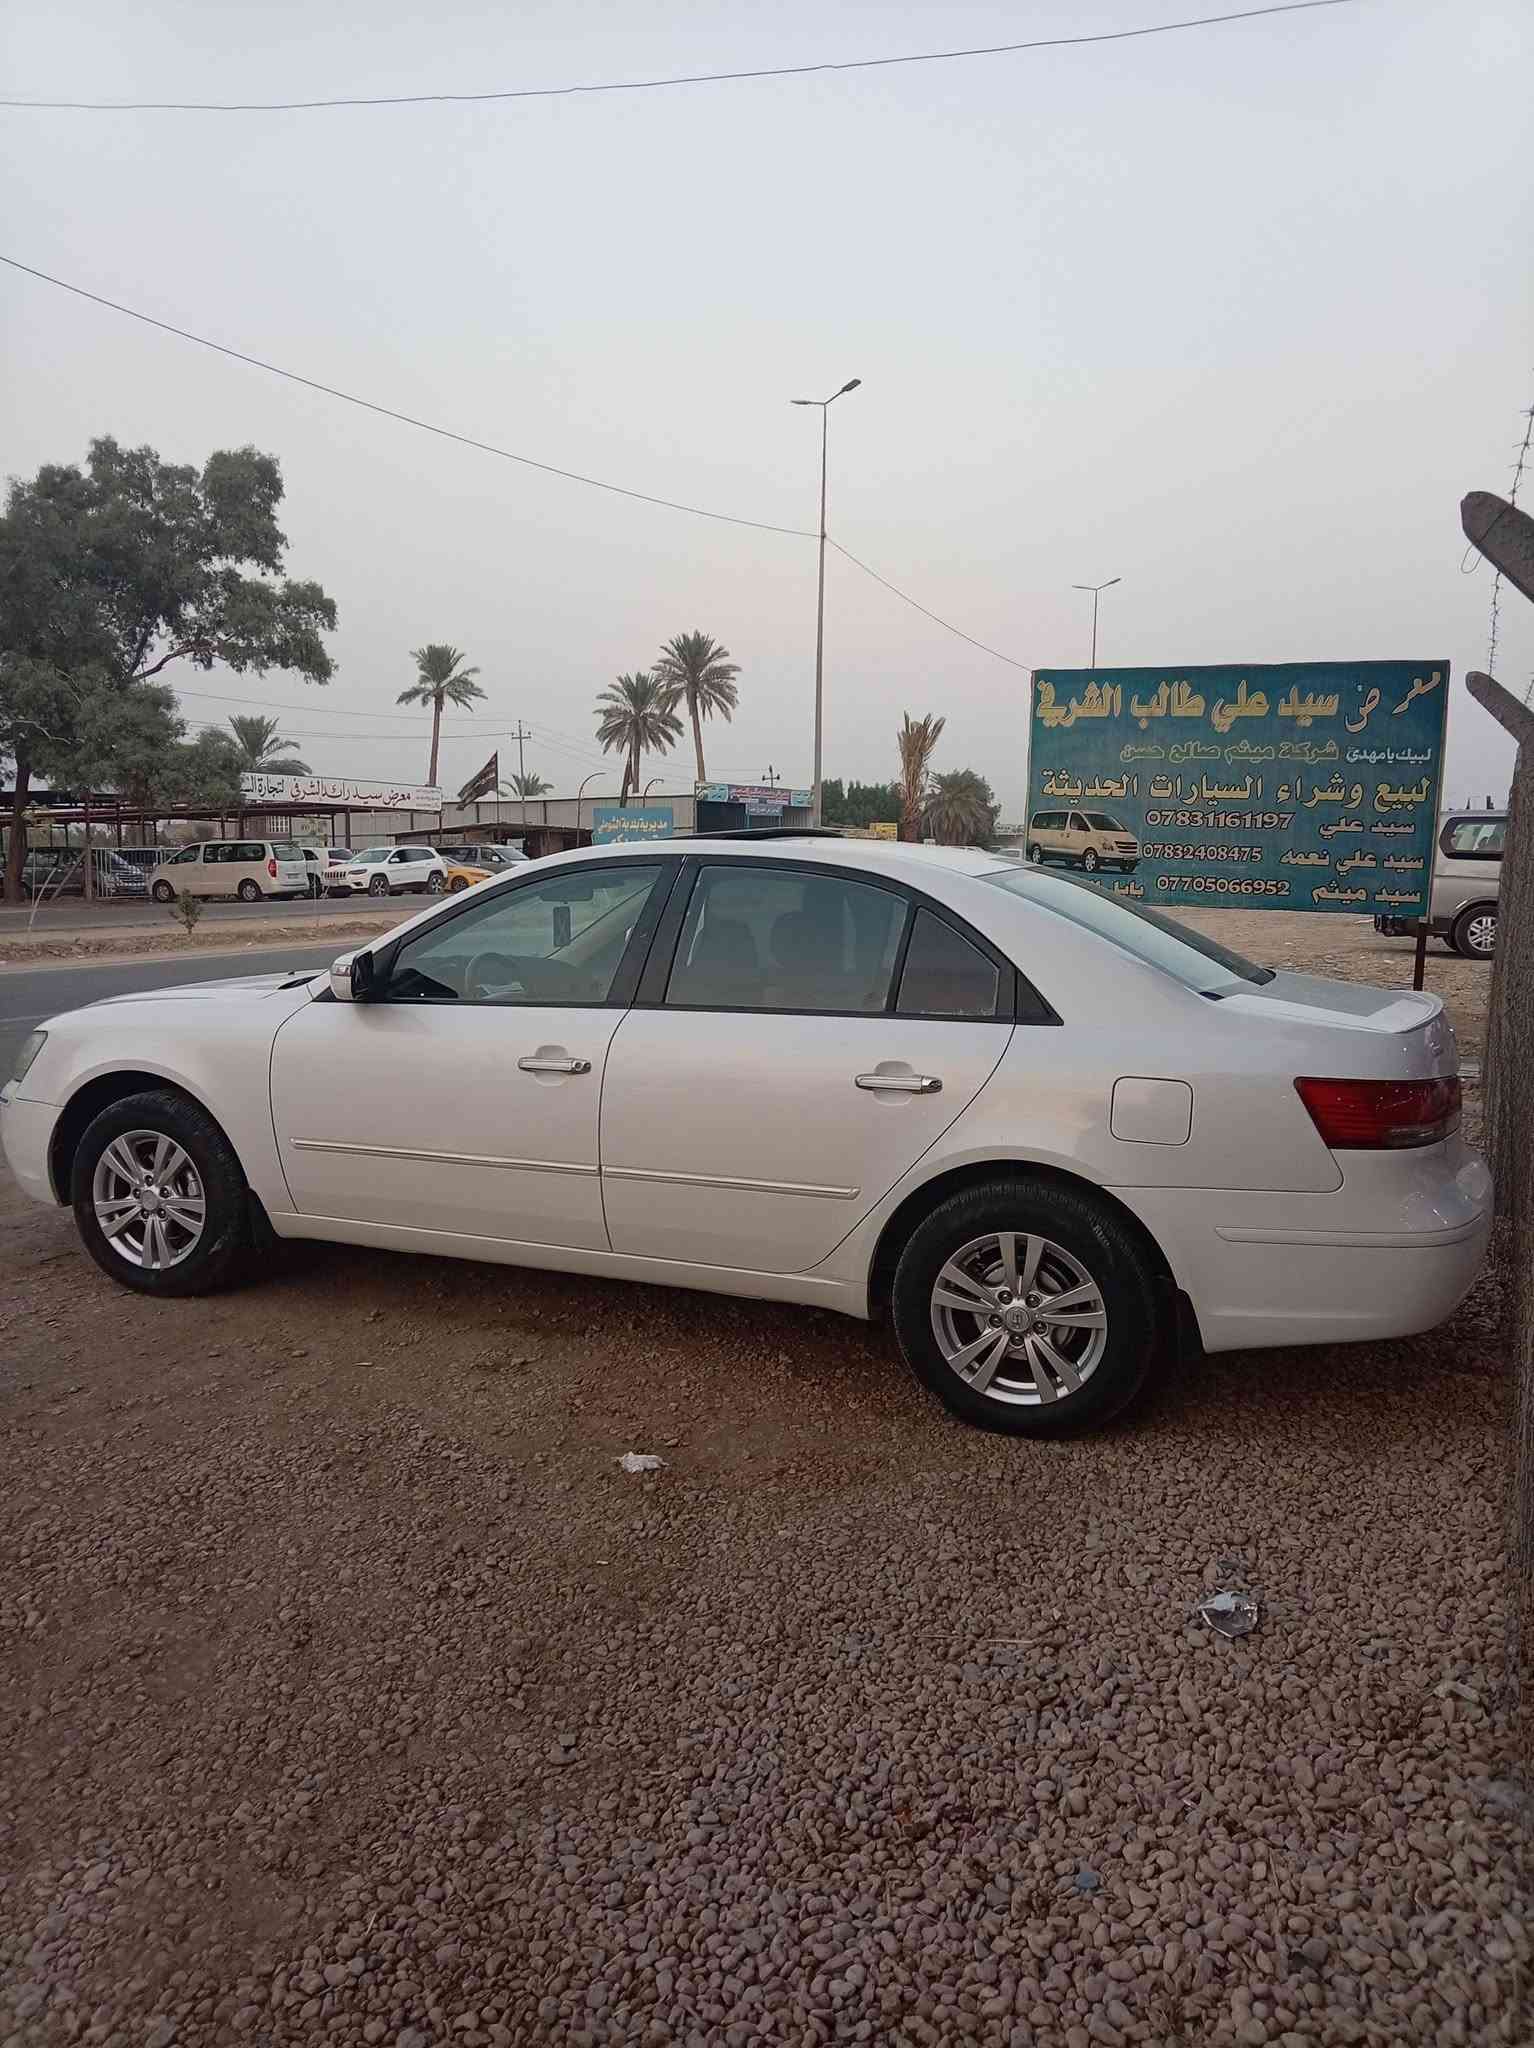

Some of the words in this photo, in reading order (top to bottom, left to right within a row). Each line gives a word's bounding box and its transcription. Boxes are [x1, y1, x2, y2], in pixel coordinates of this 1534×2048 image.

[1130, 681, 1206, 729] طالب
[1211, 680, 1270, 733] علي
[1278, 686, 1340, 727] سيد
[1119, 743, 1165, 763] حسن
[1169, 741, 1221, 764] صالح
[1224, 739, 1275, 765] ميثم
[1279, 738, 1339, 764] شركة
[257, 775, 285, 798] لتجارة
[322, 782, 350, 801] رائد
[352, 786, 382, 804] سيد
[383, 789, 411, 807] معرض
[1041, 768, 1138, 806] الحديثة
[1150, 773, 1264, 806] السيارات
[1276, 772, 1364, 809] وشراء
[1373, 776, 1432, 813] لبيع
[1145, 810, 1296, 830] 07831161197
[1319, 816, 1364, 839] علي
[1370, 820, 1415, 837] سيد
[1142, 843, 1263, 863] 07832408475
[1335, 849, 1377, 875] علي
[1383, 853, 1424, 873] سيد
[1156, 876, 1291, 896] 07705066952
[1312, 880, 1368, 904] ميثم
[1374, 887, 1421, 905] سيد
